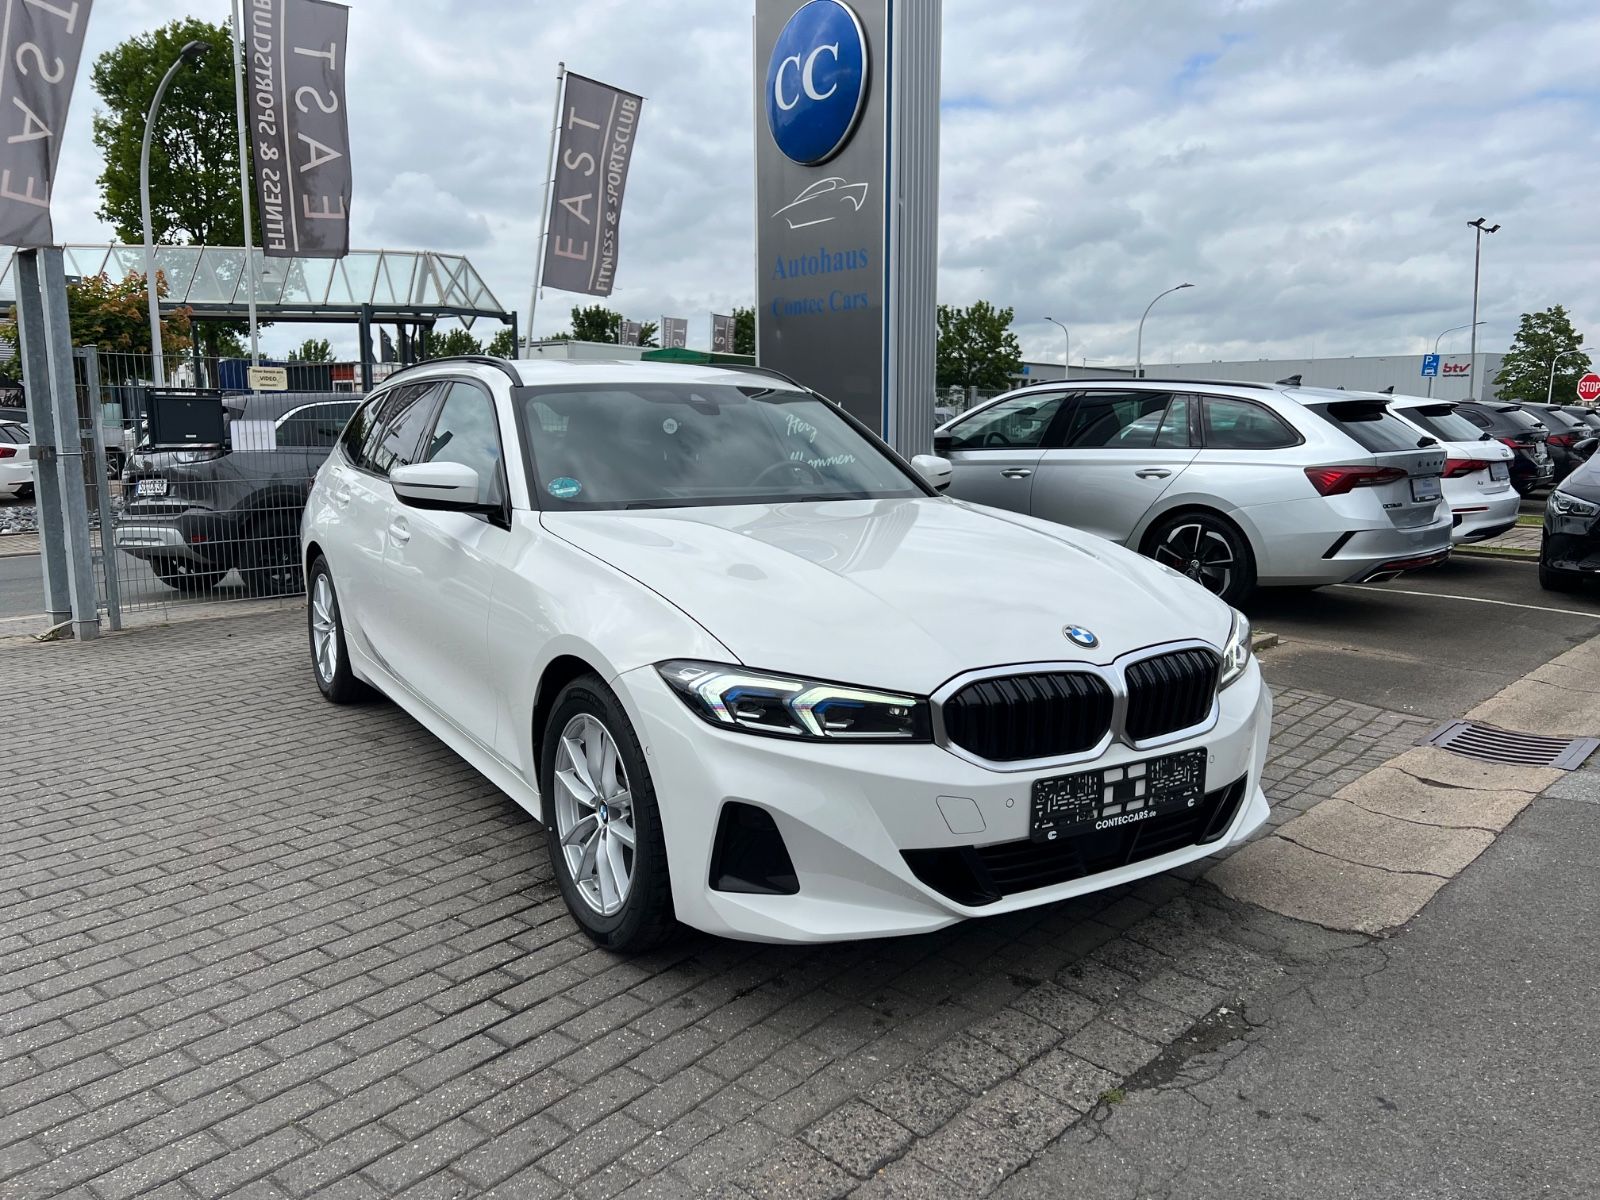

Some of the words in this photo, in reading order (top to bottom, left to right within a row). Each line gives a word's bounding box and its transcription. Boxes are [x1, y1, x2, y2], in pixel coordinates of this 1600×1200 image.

[774, 42, 839, 111] CC
[607, 98, 638, 206] SPORTSCLUB
[554, 106, 601, 262] EAST
[606, 211, 616, 226] &
[596, 229, 614, 292] FITNESS
[771, 246, 869, 281] Autohaus
[770, 296, 824, 319] Contec
[829, 289, 869, 313] Cars
[1425, 356, 1433, 365] P
[1442, 362, 1472, 374] btv
[1579, 381, 1600, 394] STOP
[1095, 809, 1157, 830] CONTECCARS.de
